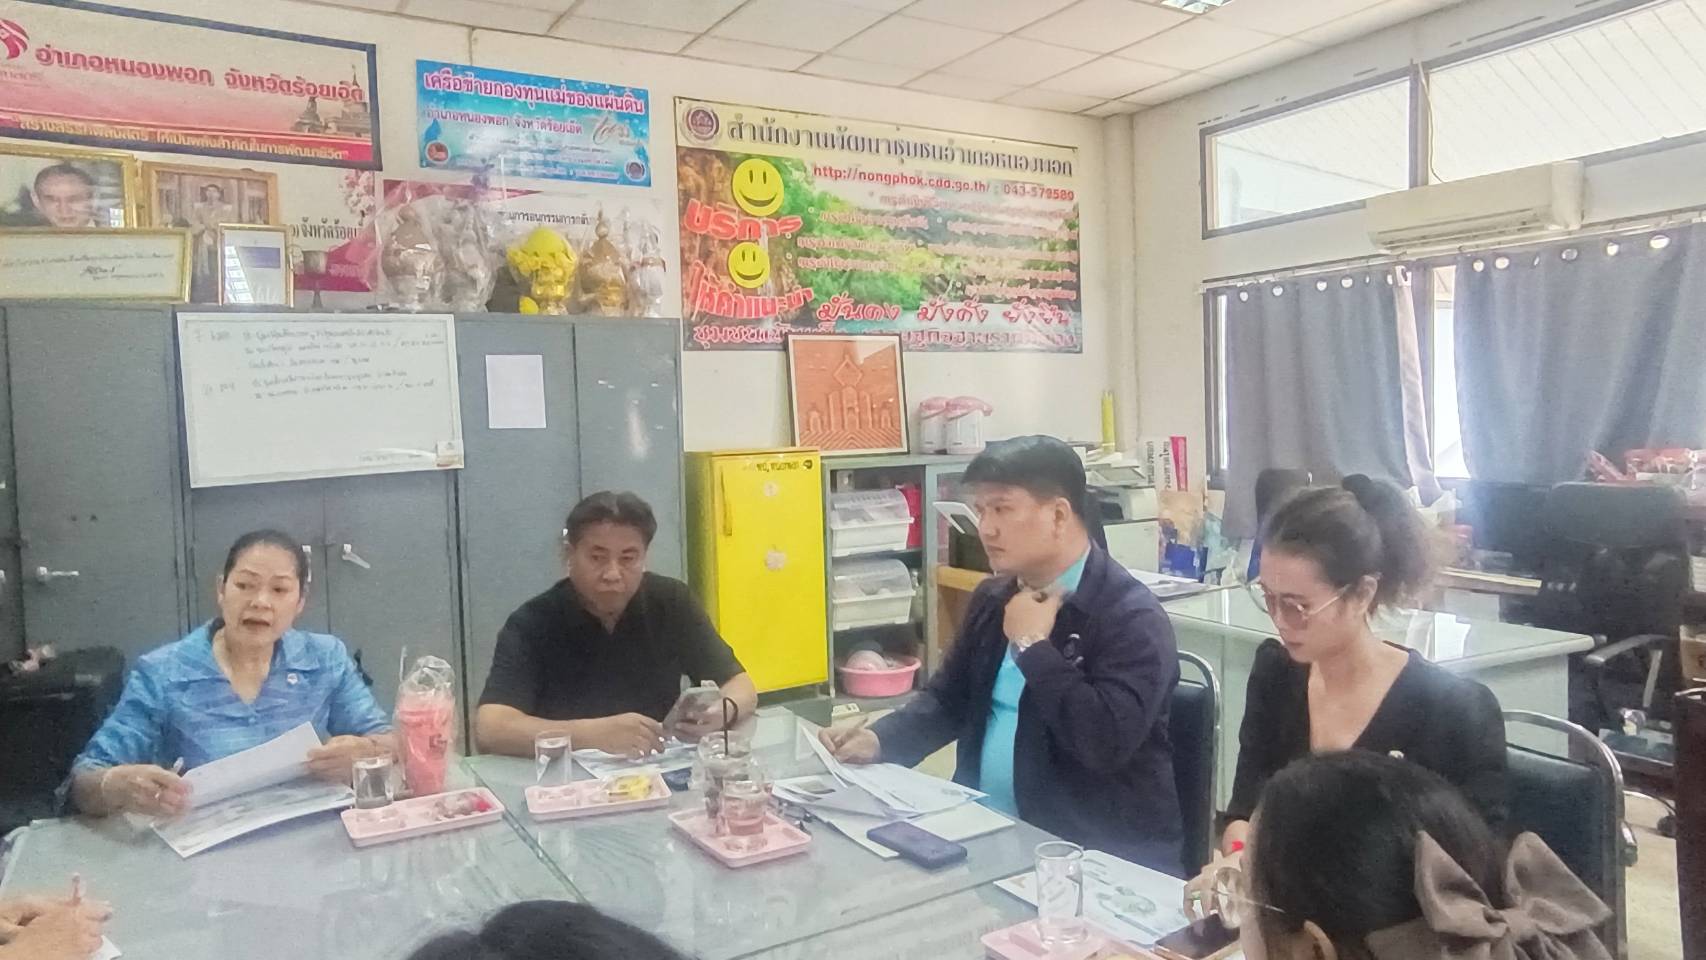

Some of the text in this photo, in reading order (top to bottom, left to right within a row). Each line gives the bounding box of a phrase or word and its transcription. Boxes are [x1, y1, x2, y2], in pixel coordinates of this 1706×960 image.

[35, 44, 214, 87] อำเภอหนองพอก
[224, 67, 365, 103] จังหวัดร้อยเอ็ด
[424, 67, 645, 114] เครือข่ายกองทุนแม่ของแผ่นดิน
[727, 112, 1073, 178] สำนักงานพัฒนาชุมชนอำเภอหนองพอก
[684, 198, 803, 241] บริการ
[687, 259, 815, 321] ให้คำแนะนำ
[816, 291, 901, 323] มั่นคง
[916, 292, 989, 323] มั่งคั่ง
